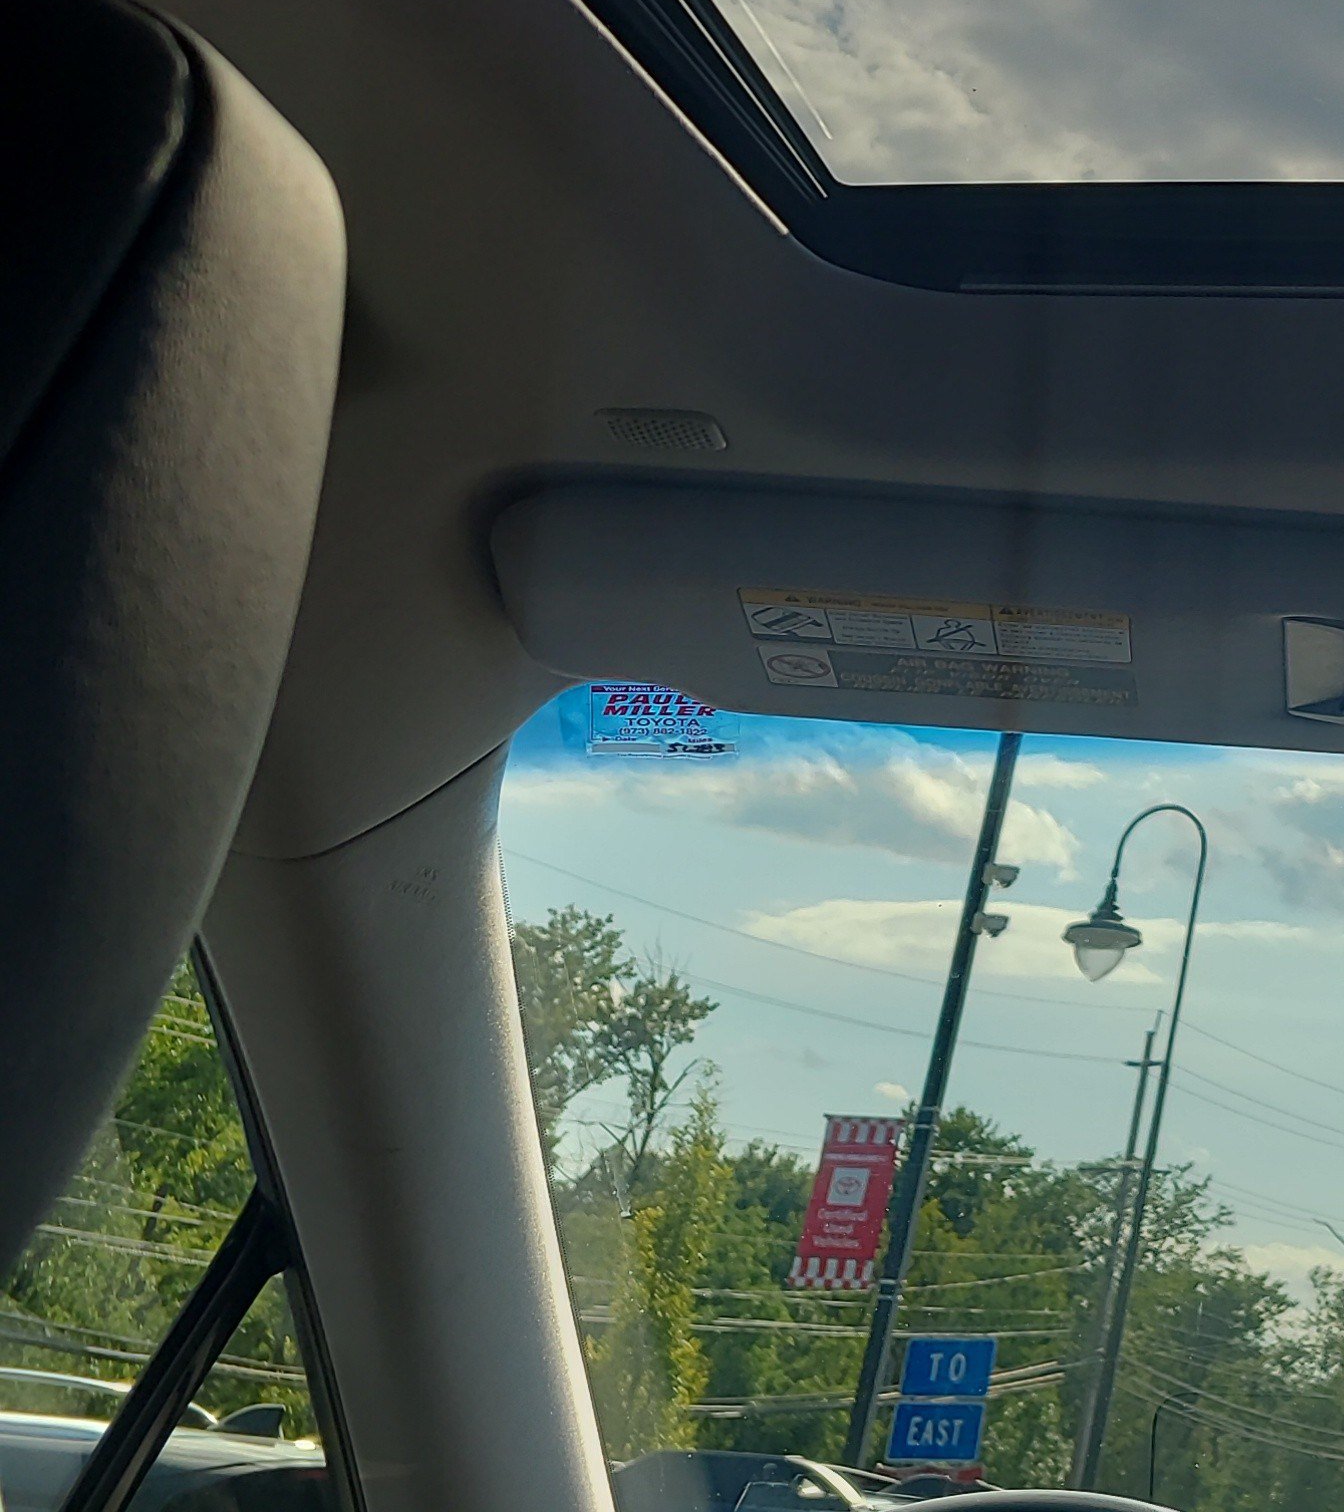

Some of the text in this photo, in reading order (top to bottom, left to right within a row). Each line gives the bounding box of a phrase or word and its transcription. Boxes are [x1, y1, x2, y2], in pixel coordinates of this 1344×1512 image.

[607, 693, 688, 705] PAUL
[603, 705, 717, 716] MILLER
[626, 717, 700, 727] TOYOTA
[618, 727, 649, 736] (973)
[929, 1352, 967, 1384] TO
[906, 1415, 964, 1447] EAST
